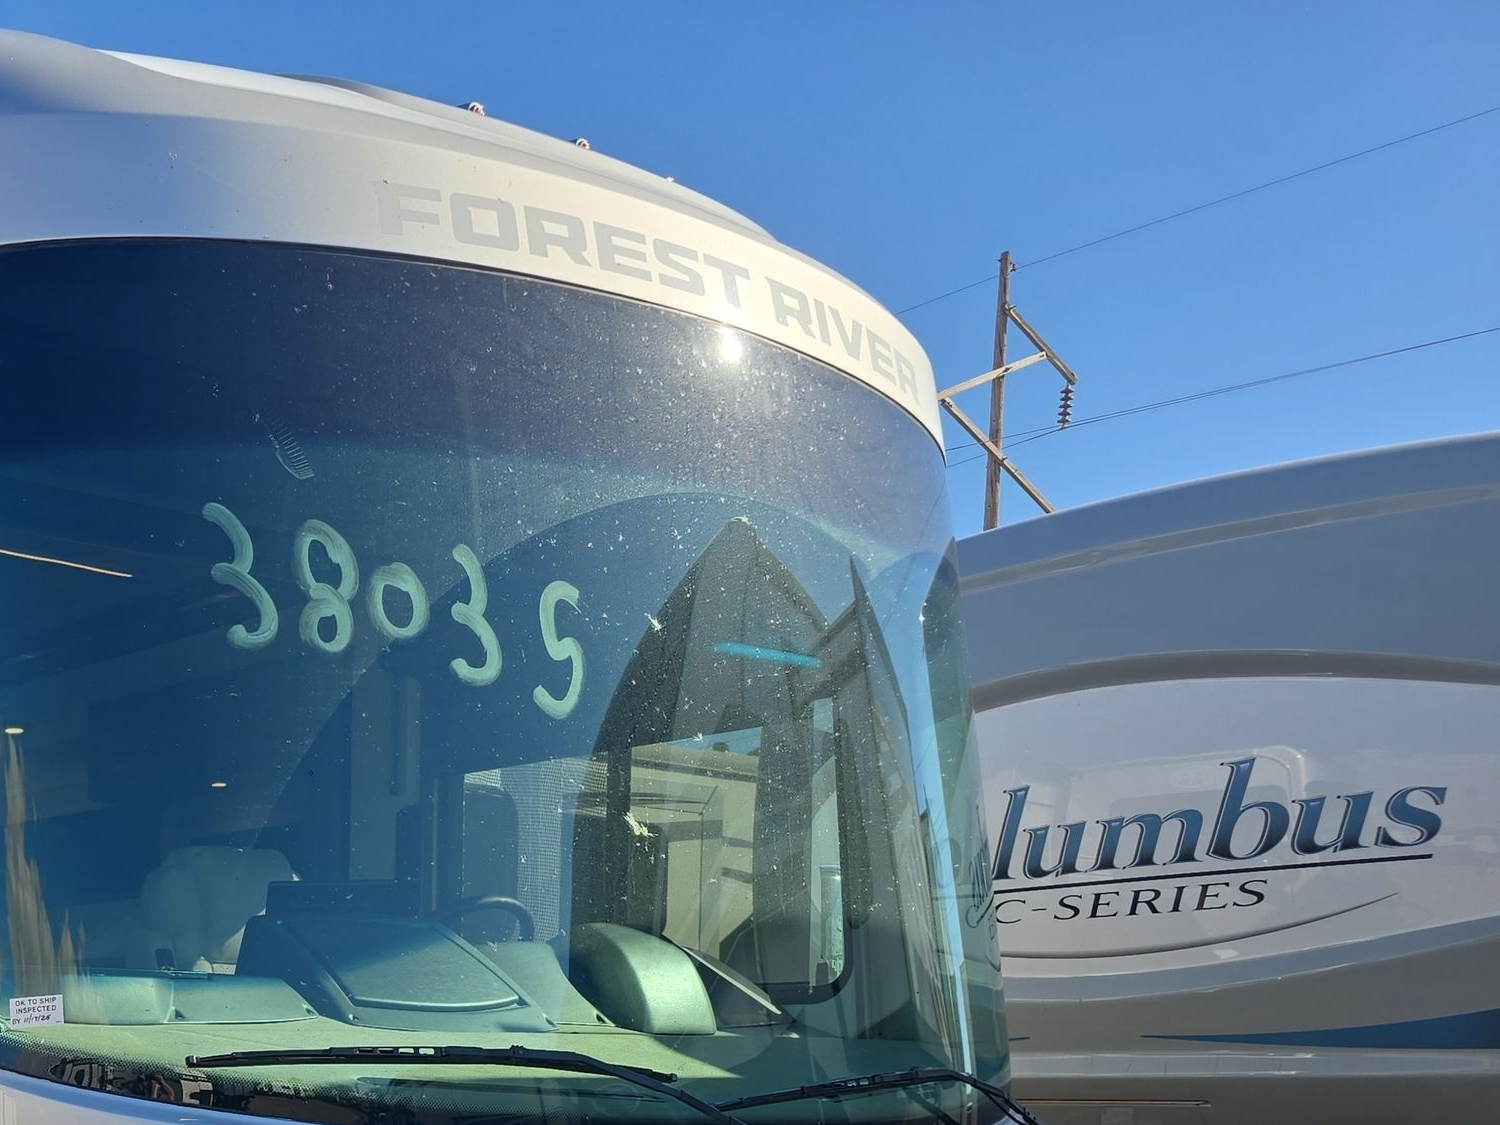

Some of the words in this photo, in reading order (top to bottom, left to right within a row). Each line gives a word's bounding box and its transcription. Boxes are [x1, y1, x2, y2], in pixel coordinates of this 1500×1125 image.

[372, 180, 751, 308] FOREST
[764, 275, 923, 409] RIVER
[993, 757, 1448, 881] lumbus
[995, 878, 1268, 925] C-SERIES
[15, 1004, 57, 1015] INSPECTED
[39, 996, 57, 1005] SHIP
